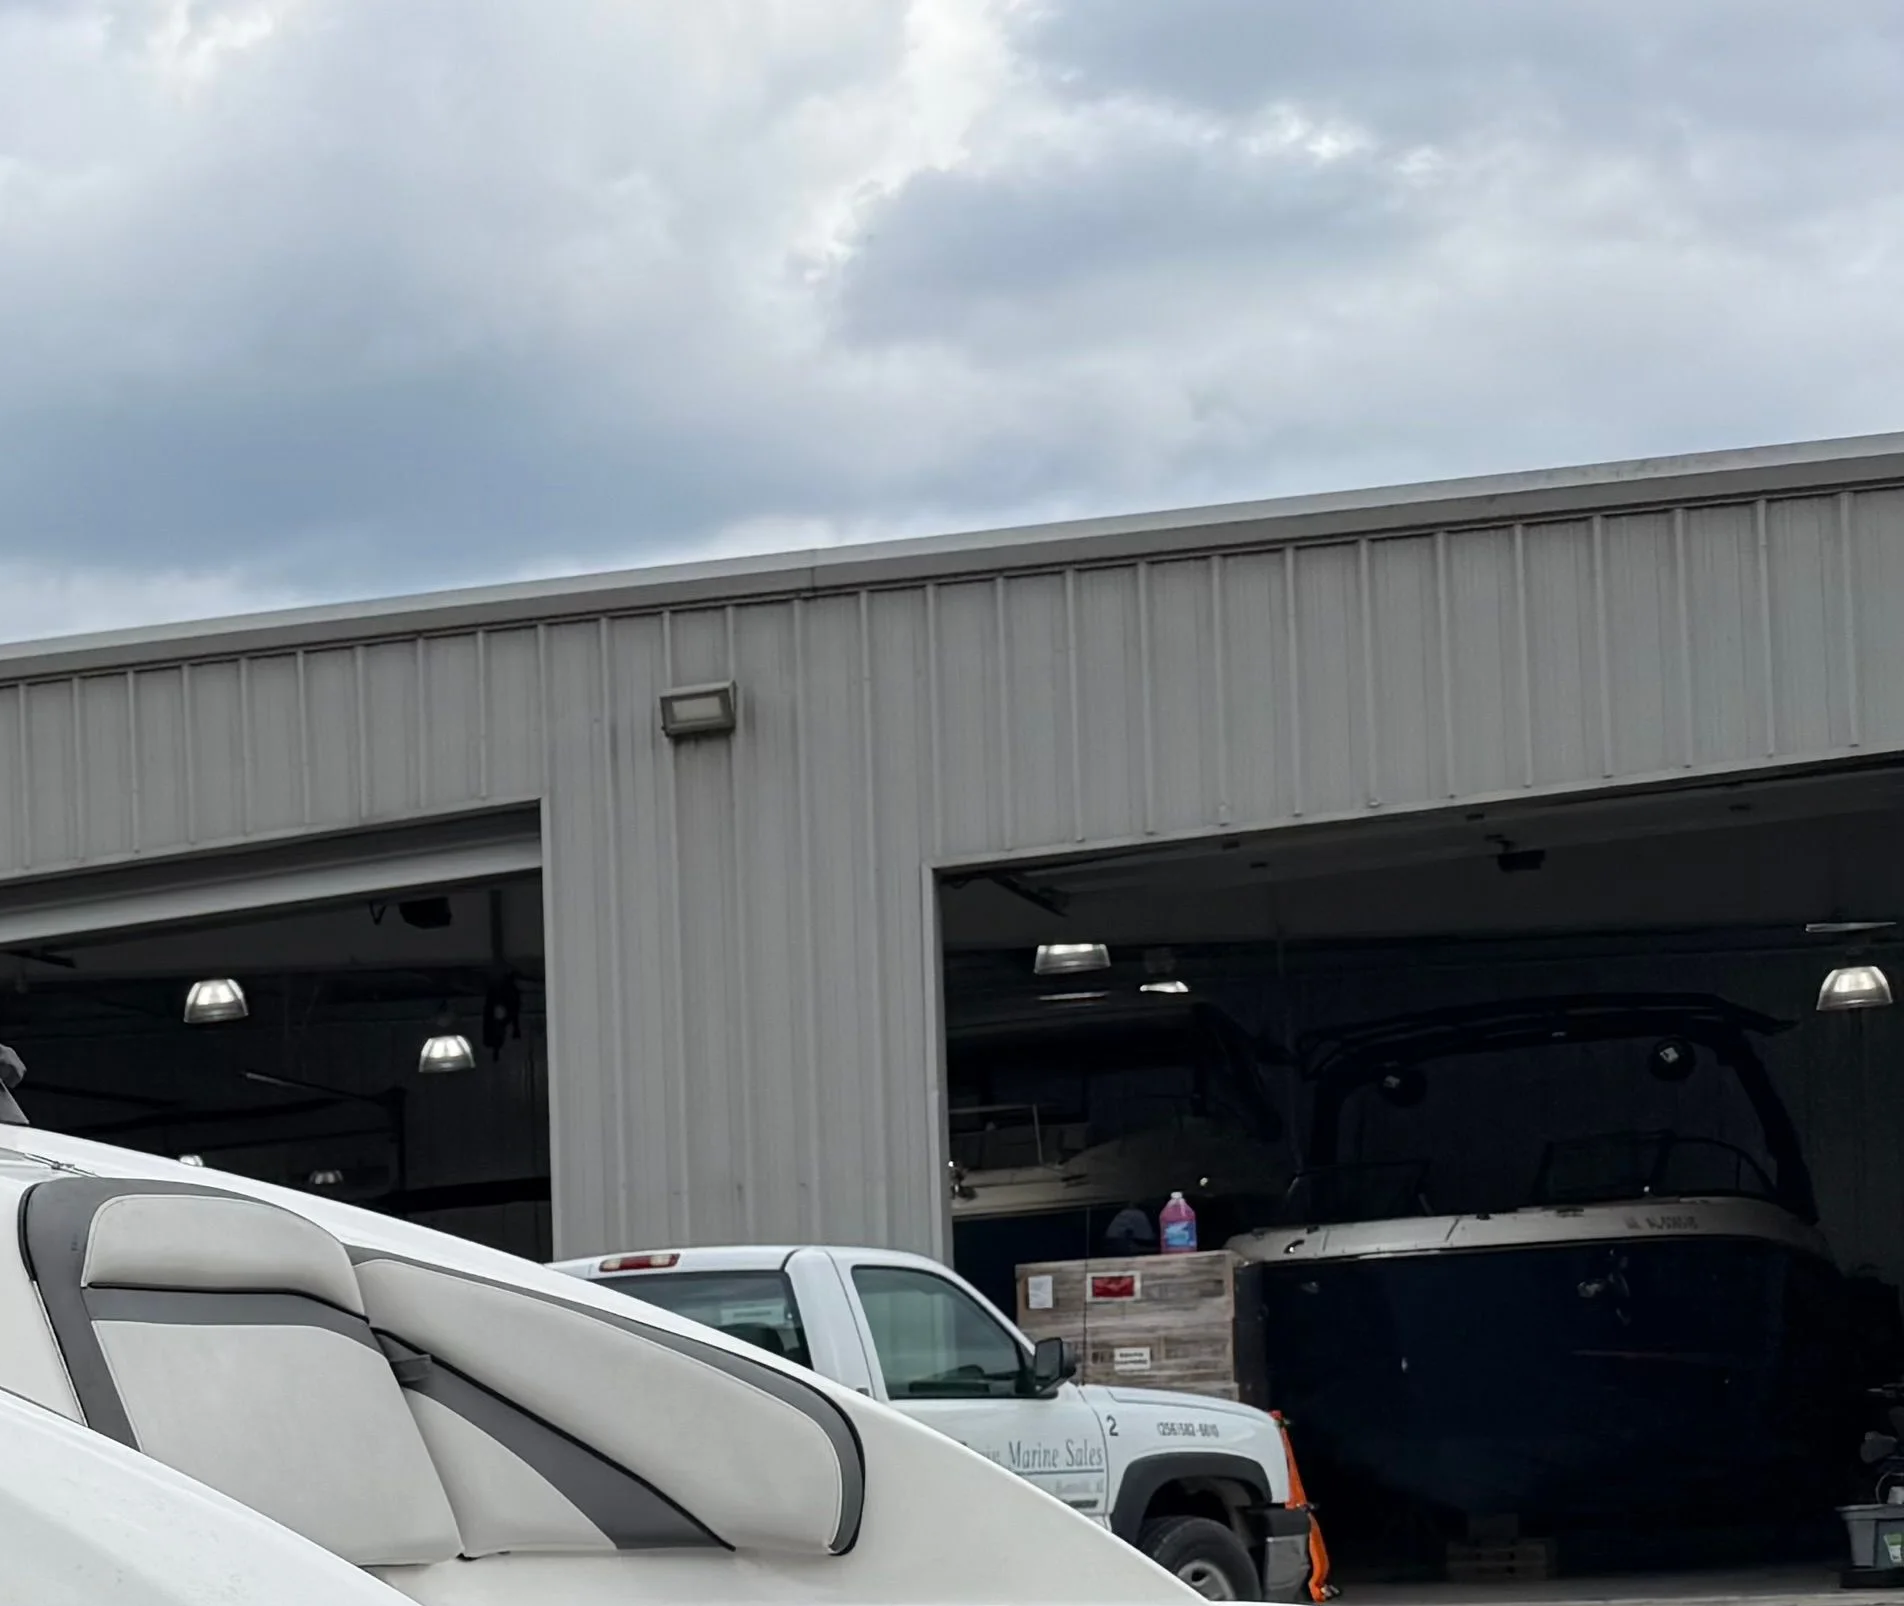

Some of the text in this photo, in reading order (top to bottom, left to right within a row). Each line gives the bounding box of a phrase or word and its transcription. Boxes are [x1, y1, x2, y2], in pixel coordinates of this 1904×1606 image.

[1106, 1414, 1119, 1436] 2
[1008, 1440, 1059, 1469] Marine
[1065, 1438, 1103, 1467] Sales
